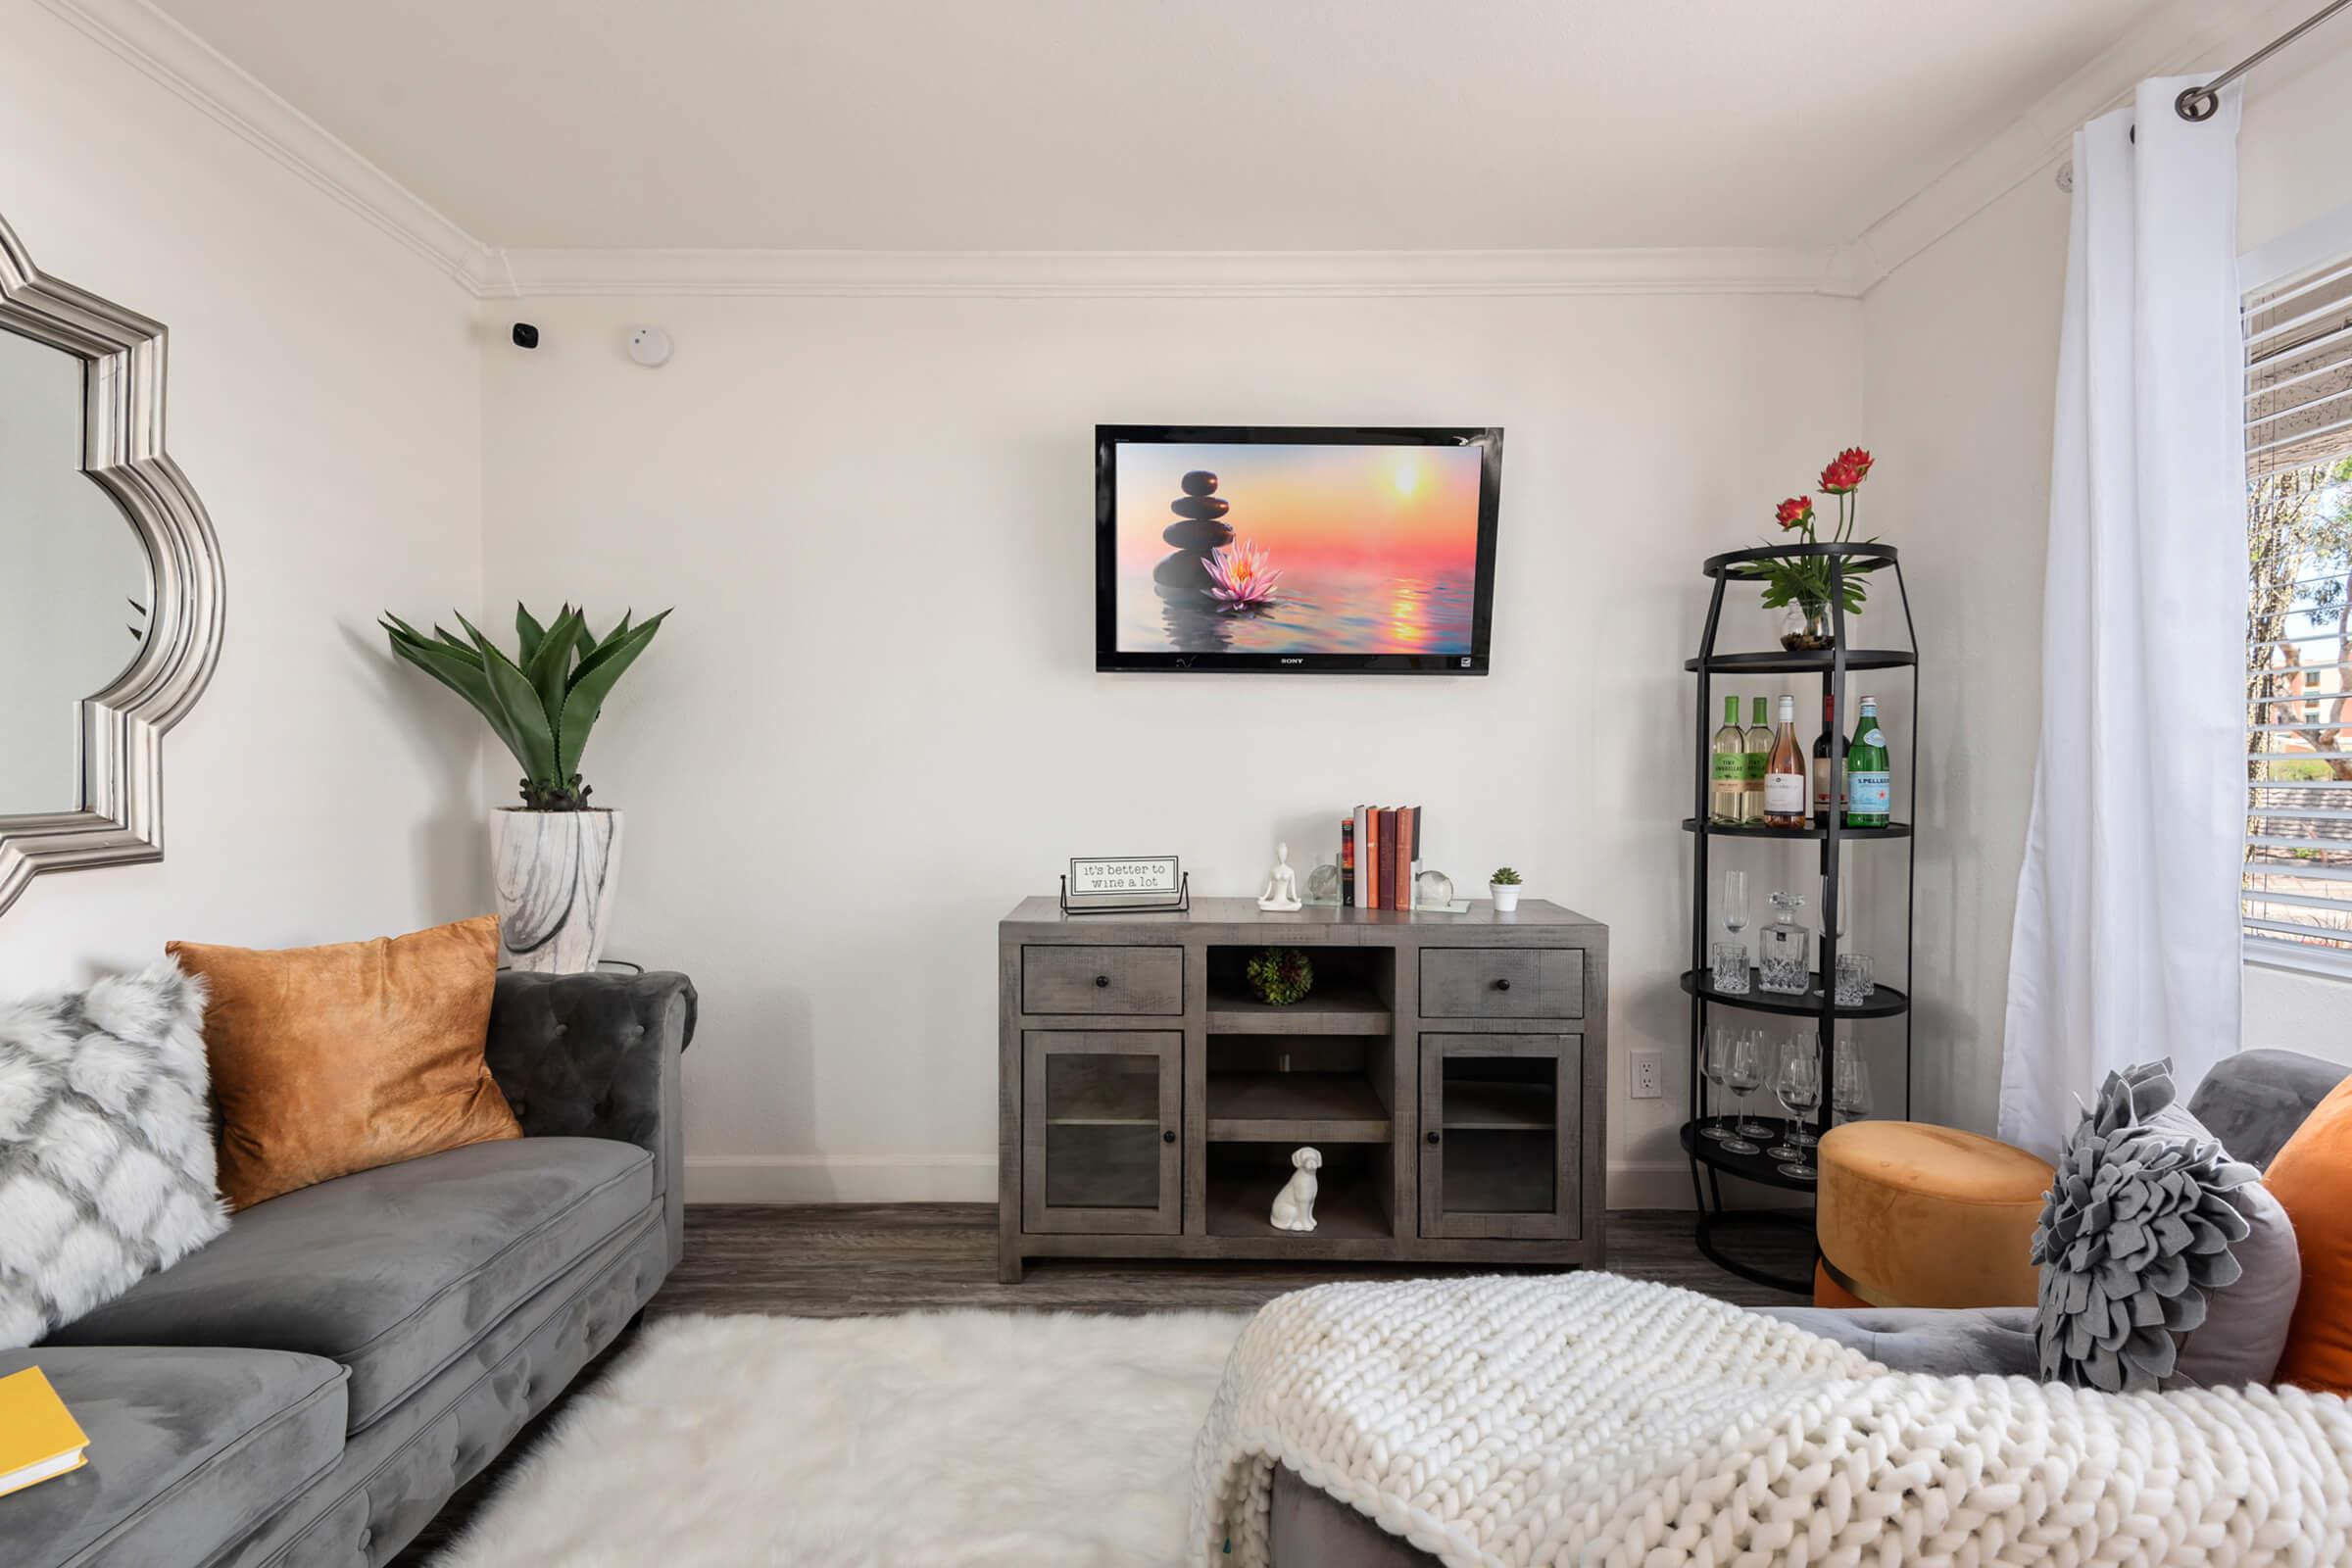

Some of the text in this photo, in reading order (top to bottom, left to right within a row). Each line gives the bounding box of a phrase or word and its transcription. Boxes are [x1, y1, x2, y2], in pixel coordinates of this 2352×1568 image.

[1084, 863, 1166, 876] it's better to
[1091, 876, 1158, 888] wine a lot
